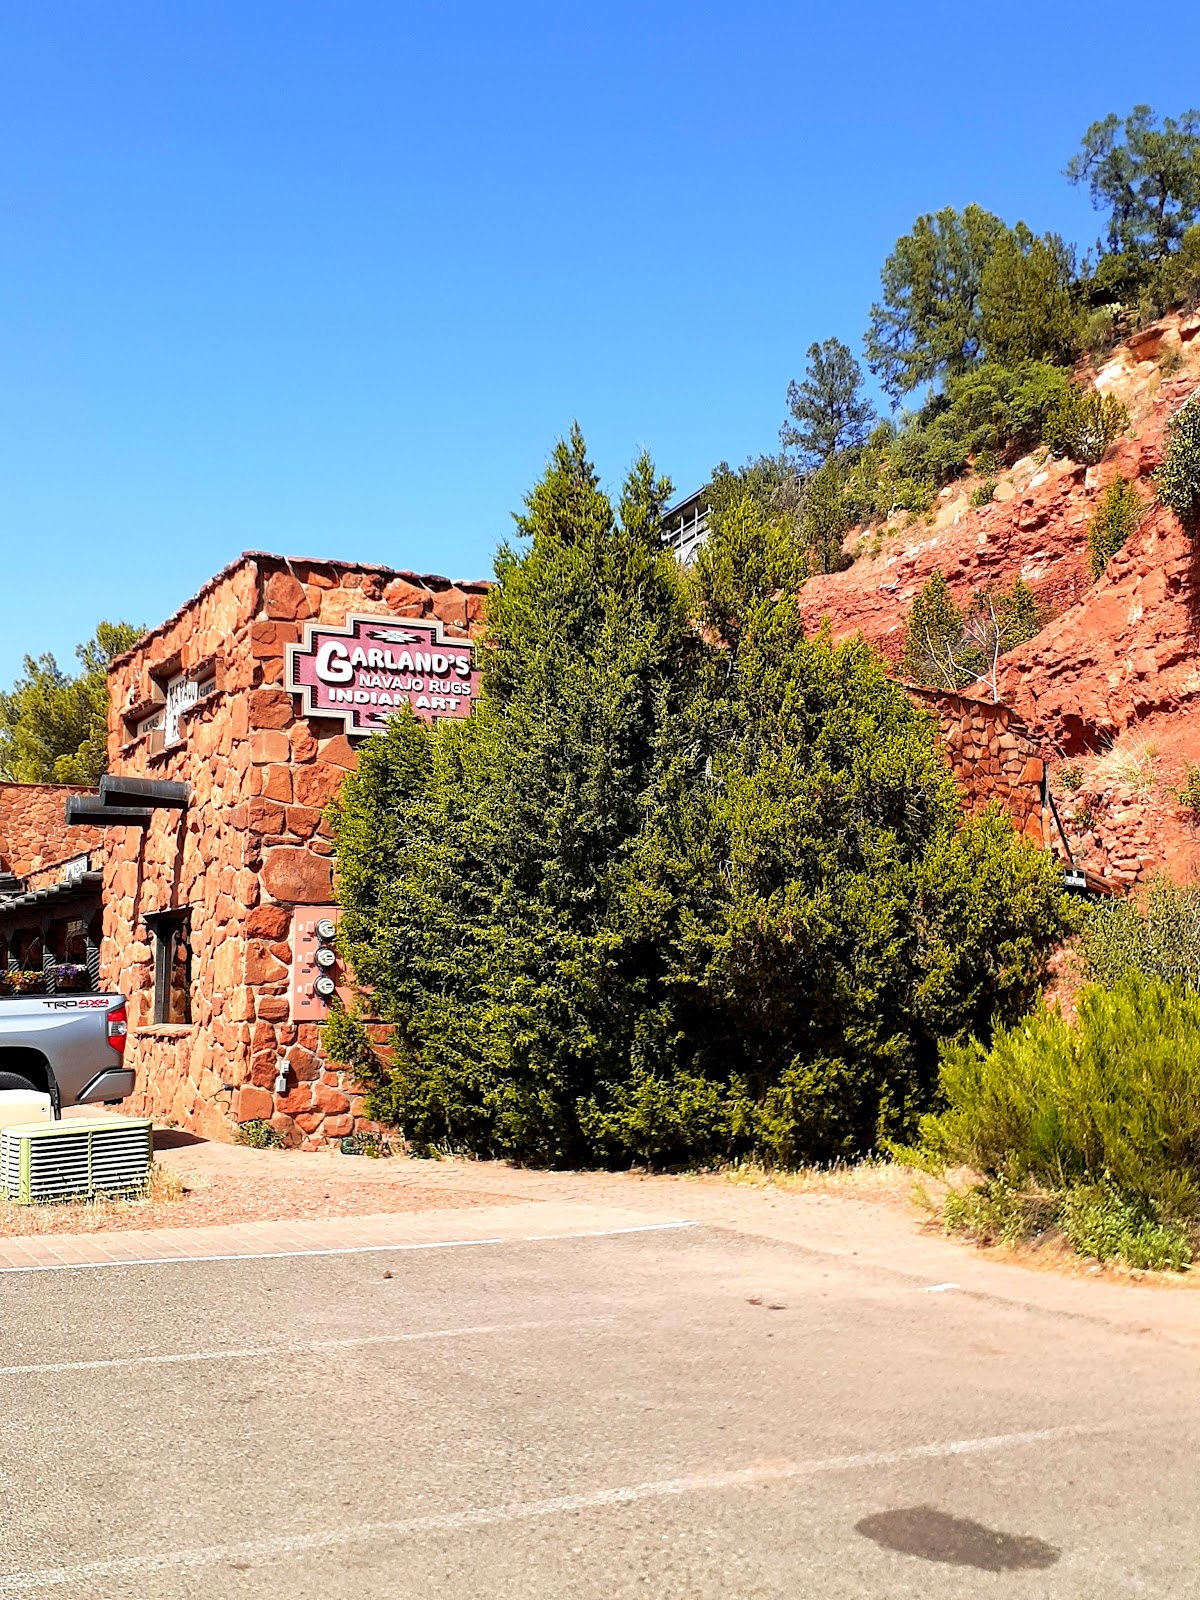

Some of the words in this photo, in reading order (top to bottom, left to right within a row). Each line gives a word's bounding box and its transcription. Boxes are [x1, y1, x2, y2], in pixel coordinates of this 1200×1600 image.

[315, 640, 470, 683] GARLAND'S
[359, 674, 424, 692] NAVAJO
[429, 680, 471, 696] RUGS
[415, 695, 461, 711] ART
